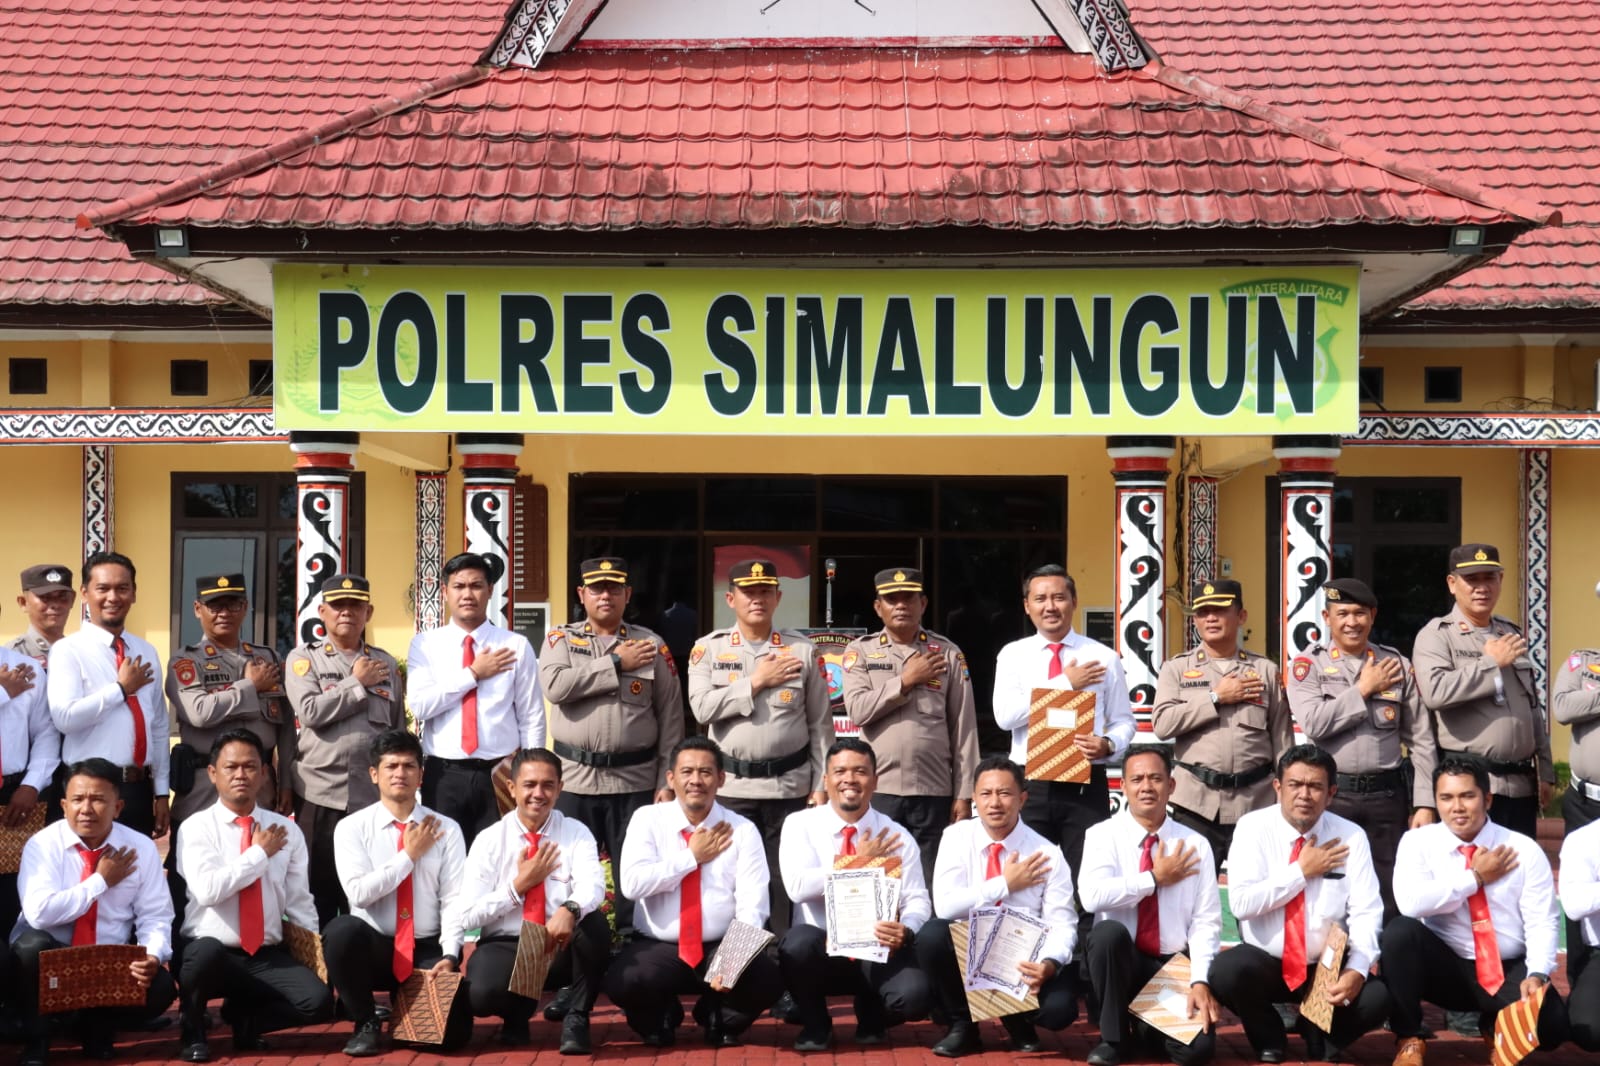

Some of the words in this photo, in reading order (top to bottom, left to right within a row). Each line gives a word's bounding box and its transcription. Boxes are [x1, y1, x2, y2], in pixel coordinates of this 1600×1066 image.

[318, 290, 673, 417] POLRES
[703, 290, 1317, 417] SIMALUNGUN
[204, 673, 230, 682] RESTU
